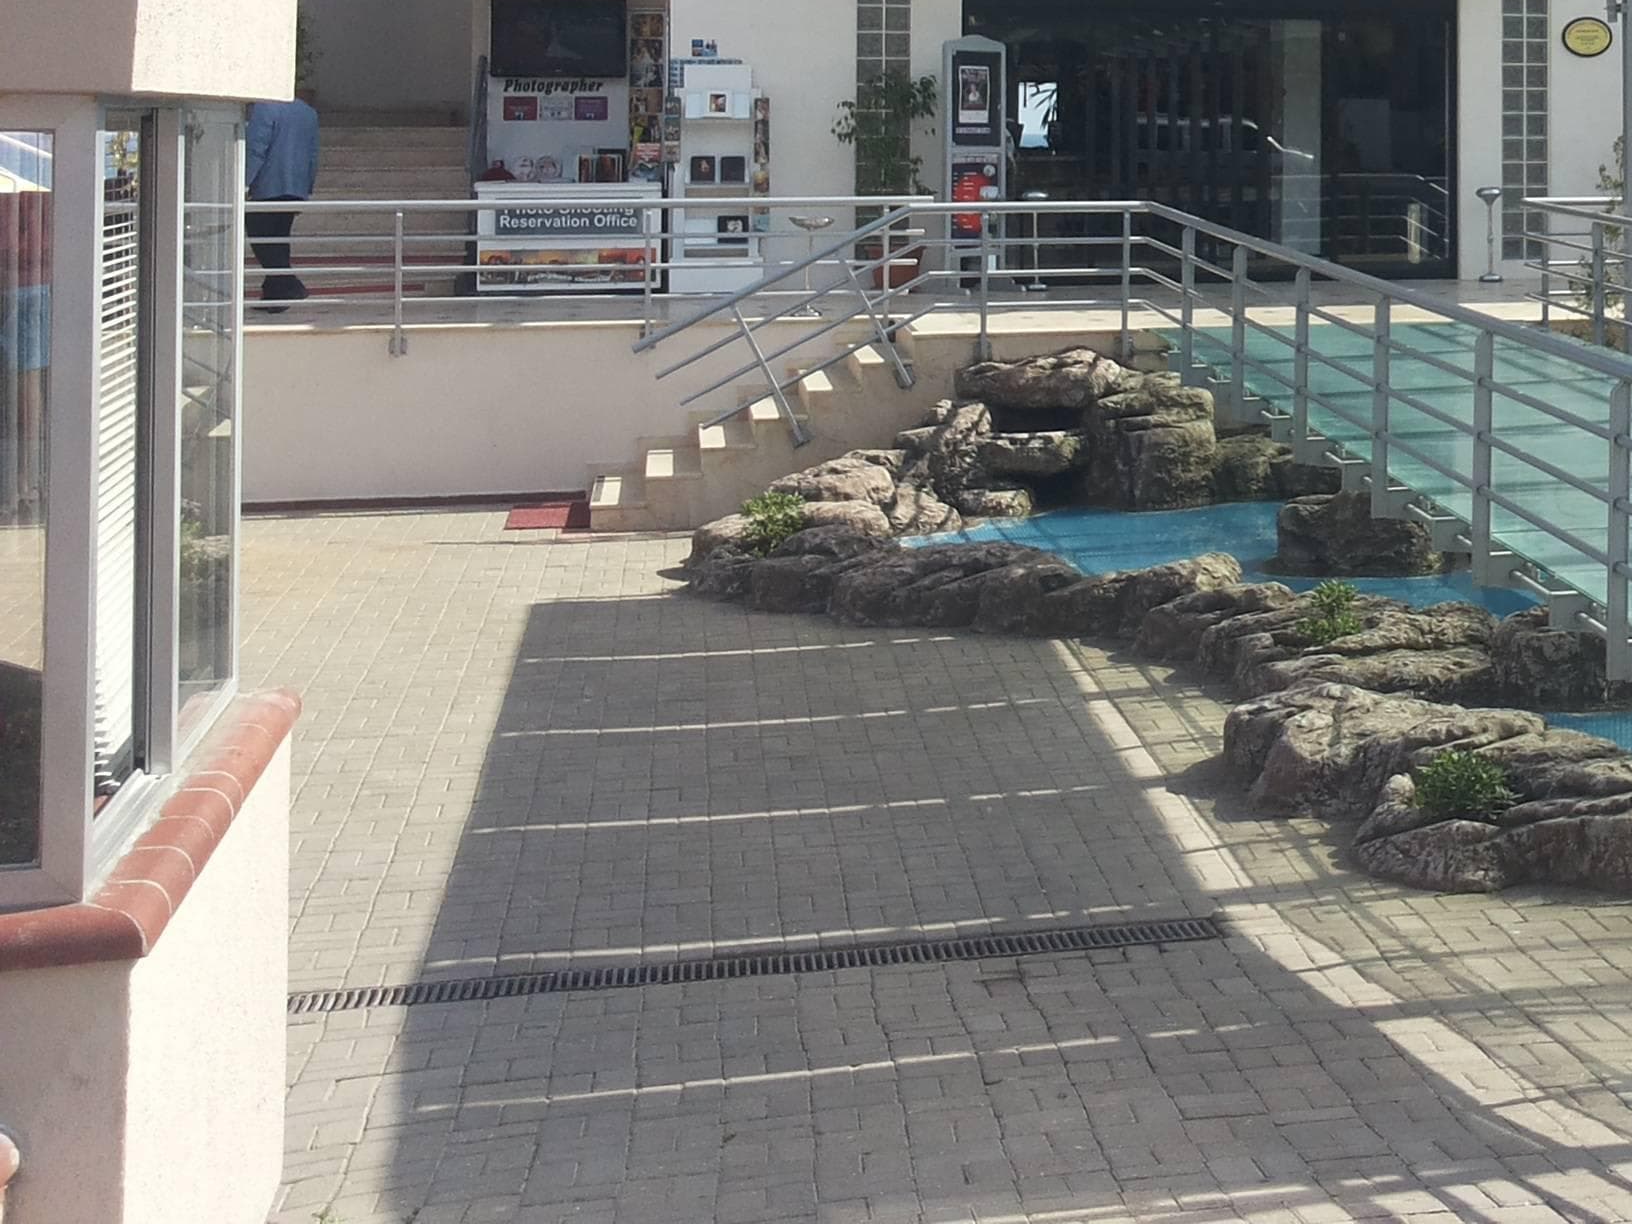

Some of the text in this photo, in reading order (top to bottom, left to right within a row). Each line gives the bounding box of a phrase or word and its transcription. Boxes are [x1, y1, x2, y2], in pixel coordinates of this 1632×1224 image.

[503, 78, 604, 95] Photographer
[500, 214, 638, 228] Reservation Office
